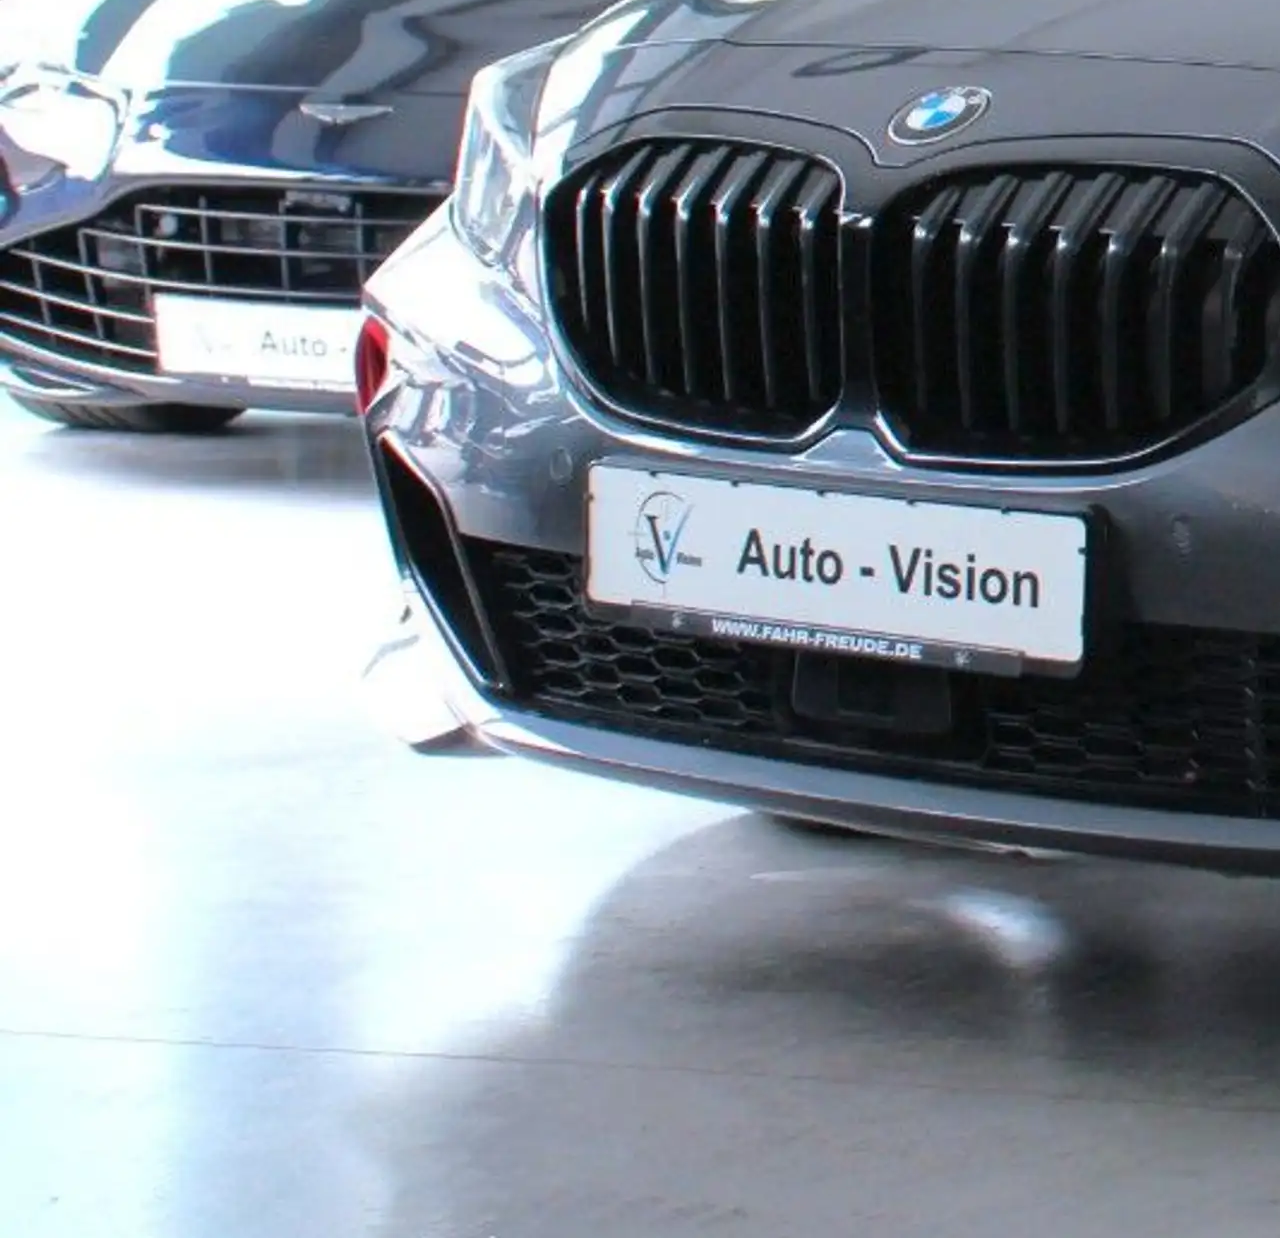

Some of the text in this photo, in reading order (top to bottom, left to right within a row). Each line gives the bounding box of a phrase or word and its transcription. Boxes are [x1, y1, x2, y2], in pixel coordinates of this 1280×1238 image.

[261, 330, 328, 357] Auto
[737, 528, 844, 586] Auto
[889, 544, 1039, 609] Vision
[711, 619, 923, 659] WWW.FAHR-FREUDE.DE
